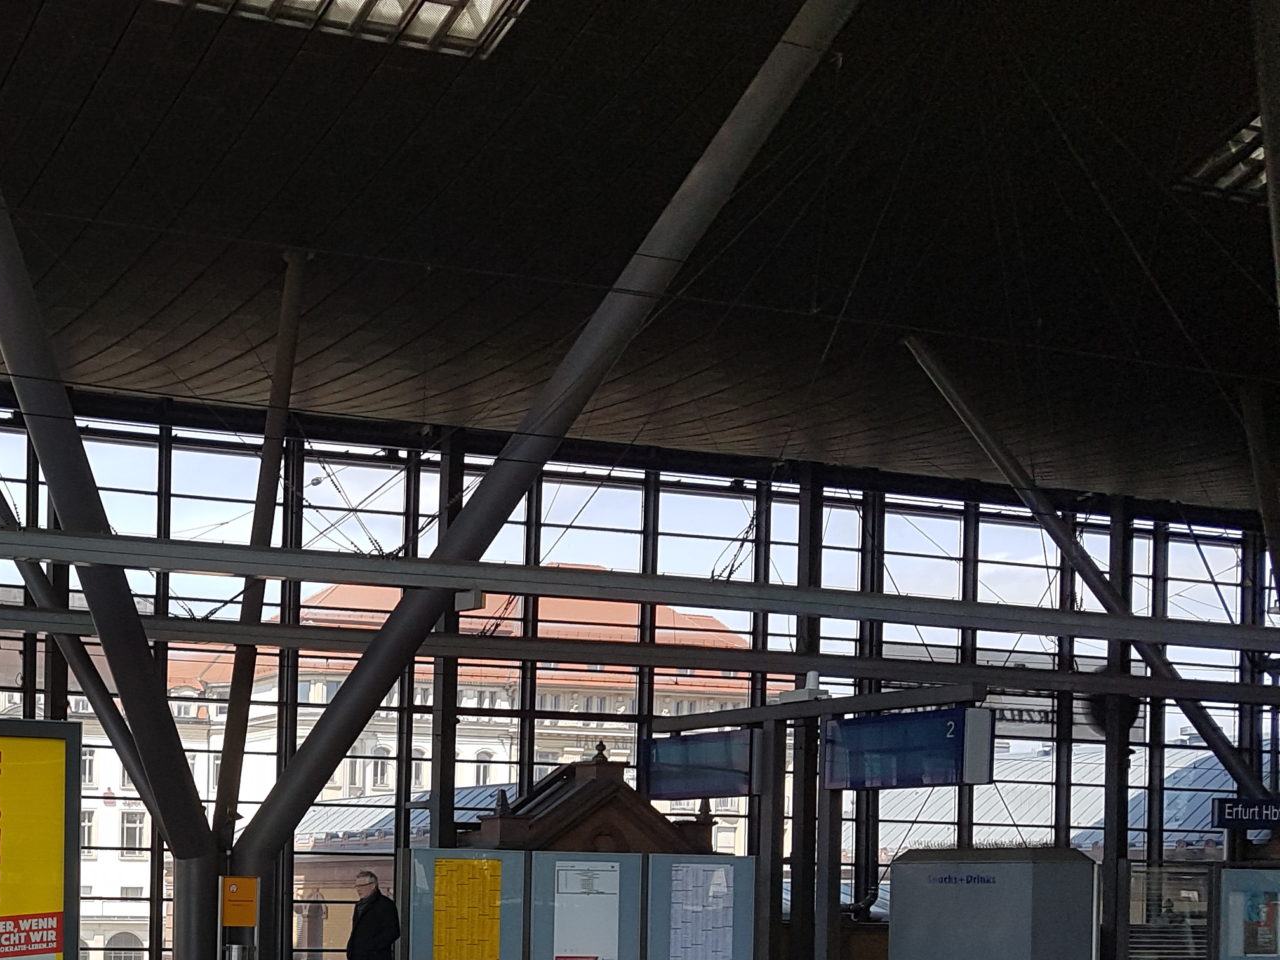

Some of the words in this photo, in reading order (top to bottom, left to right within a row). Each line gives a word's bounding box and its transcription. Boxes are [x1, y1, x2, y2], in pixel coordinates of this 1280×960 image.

[946, 721, 955, 738] 2
[1224, 803, 1259, 820] Erfurt
[1262, 804, 1280, 821] Hb
[19, 917, 58, 931] WENN
[29, 930, 57, 943] WIR
